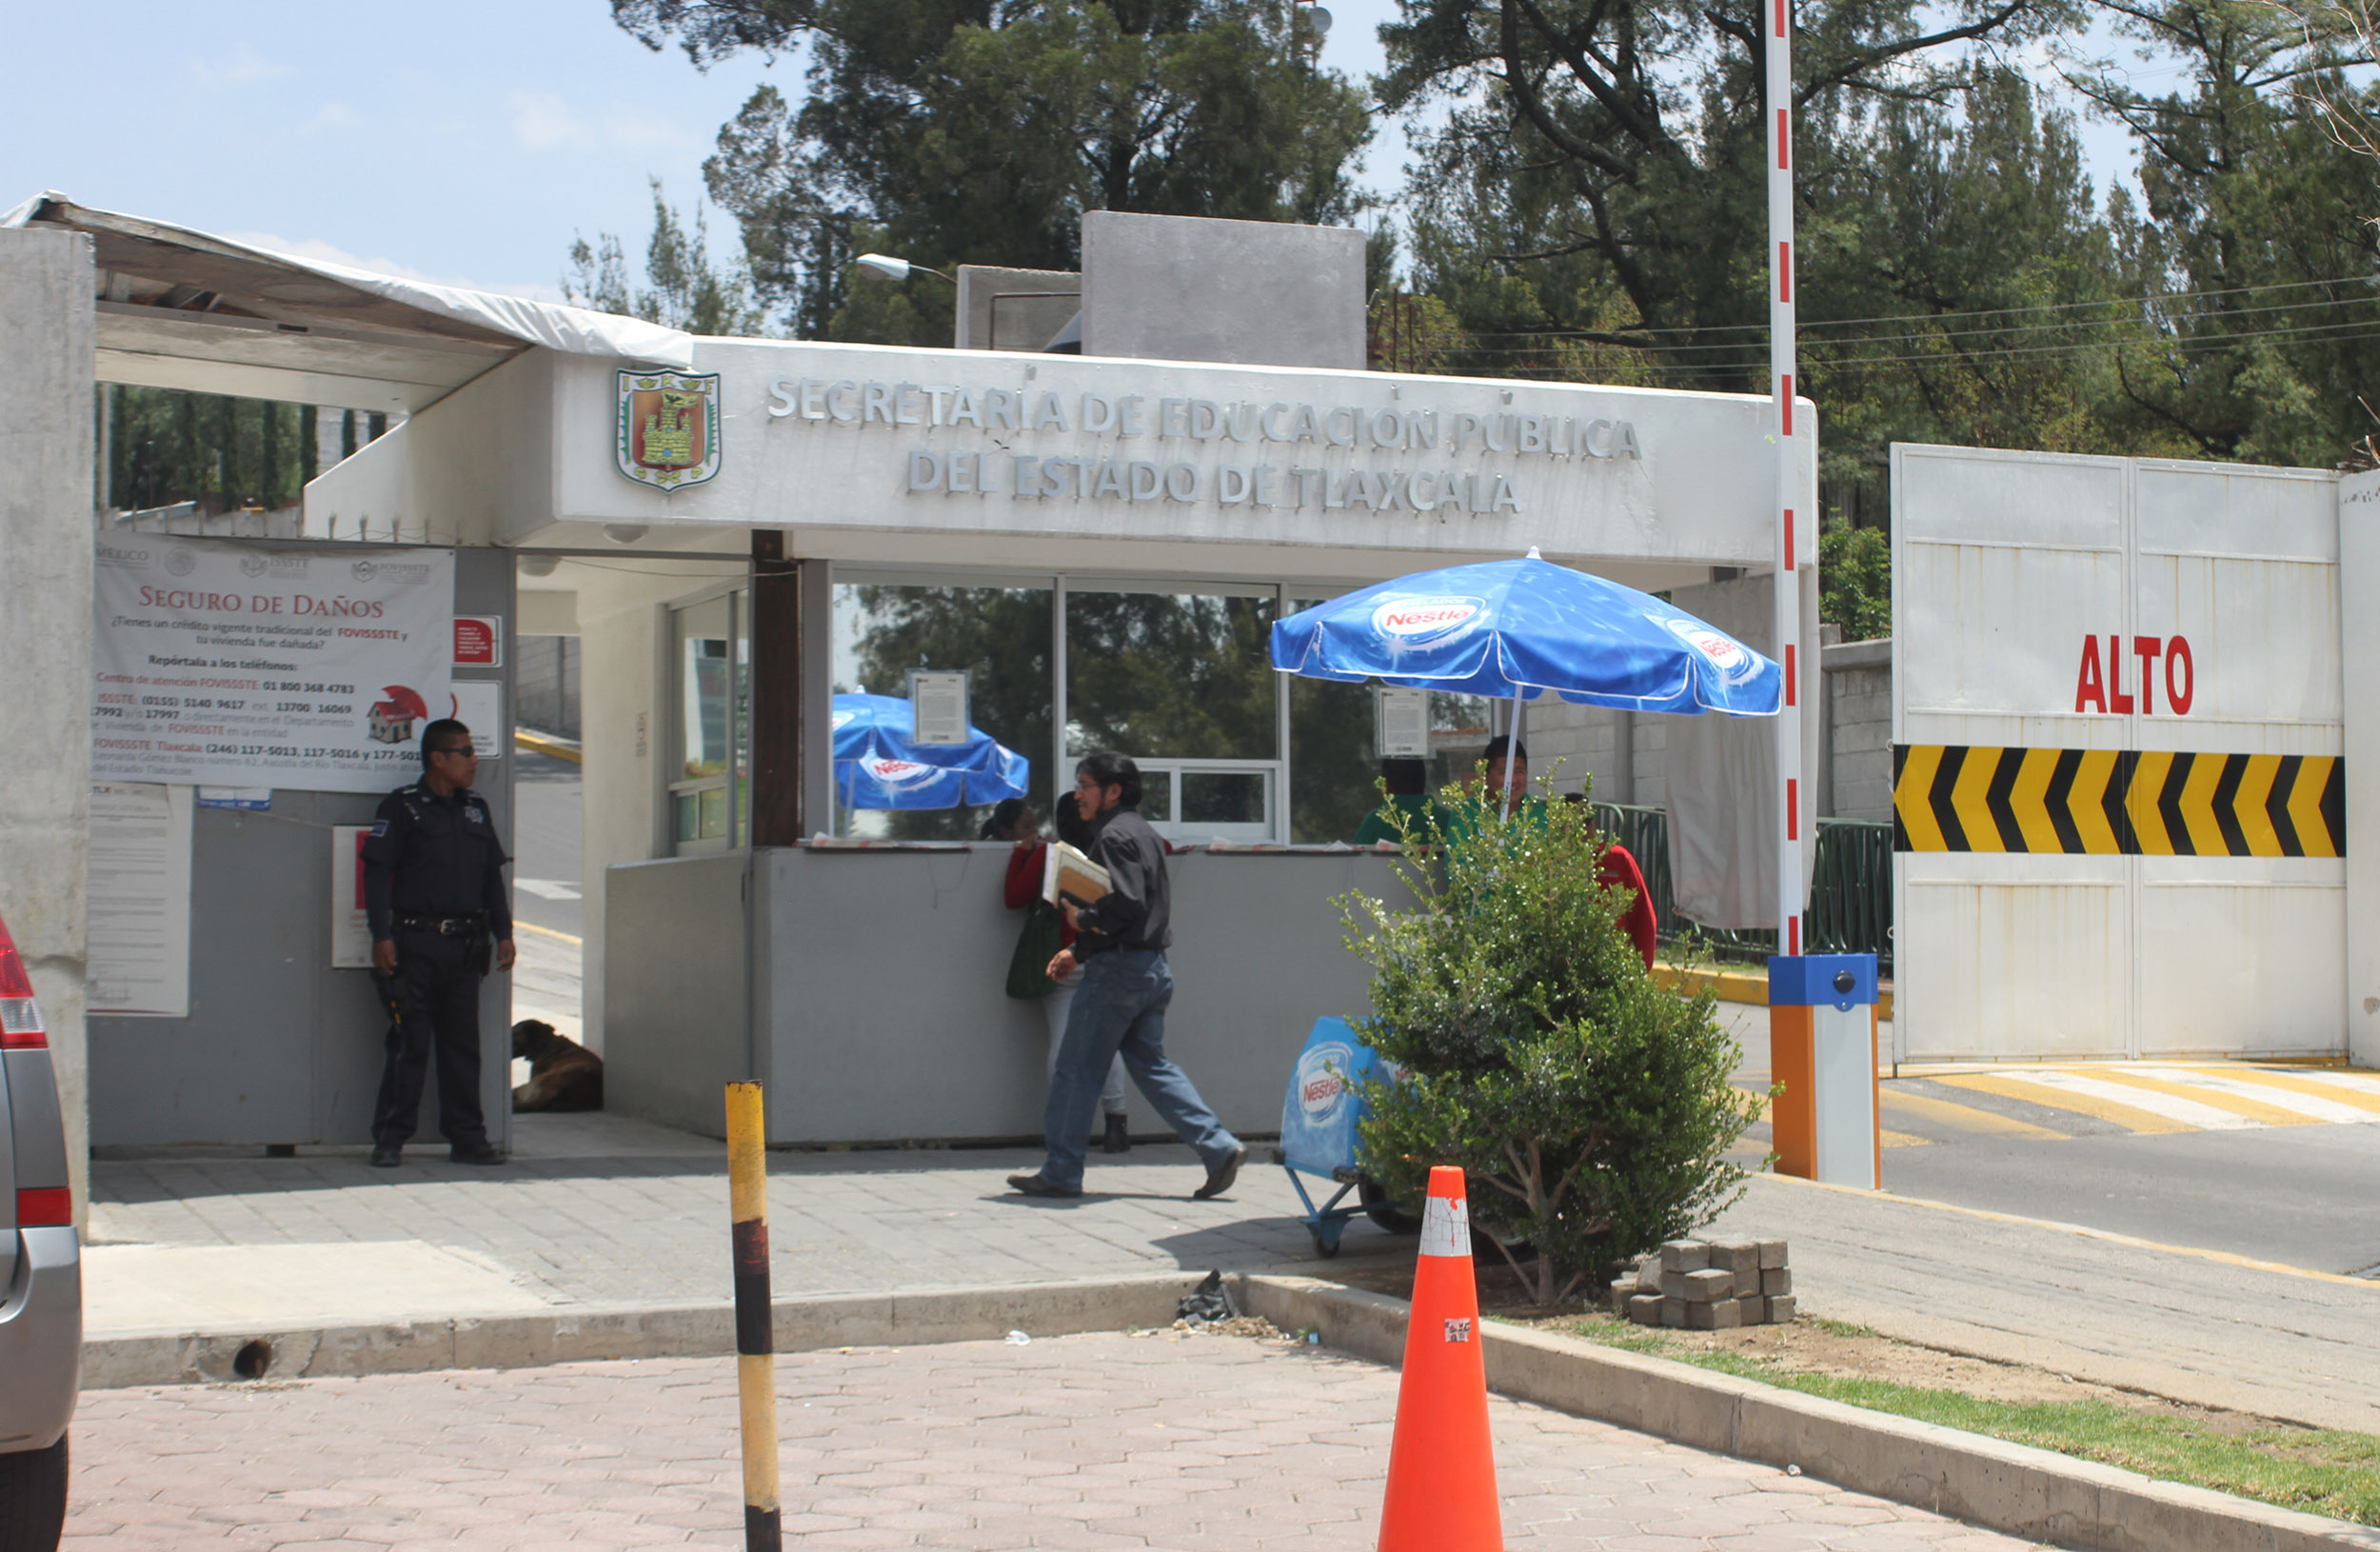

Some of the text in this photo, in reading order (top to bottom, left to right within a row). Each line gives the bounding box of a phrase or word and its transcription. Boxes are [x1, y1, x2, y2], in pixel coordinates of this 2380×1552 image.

[1082, 391, 1146, 435] DE
[909, 450, 1522, 513] DEL ESTADO DE TLAXCALA
[154, 620, 169, 628] un
[171, 618, 208, 630] crédito
[211, 622, 252, 634] vigente
[255, 625, 313, 636] tradicional
[315, 627, 332, 637] del
[337, 627, 399, 640] FOVISSSTE
[401, 632, 409, 643] y
[196, 635, 325, 650] tu vivienda fue dañada?
[149, 654, 207, 667] Repórtala
[209, 659, 218, 667] a
[220, 658, 237, 668] los
[96, 671, 133, 684] Centro
[136, 674, 149, 685] de
[152, 675, 197, 687] atención
[262, 681, 277, 691] 01
[279, 682, 301, 692] 800
[303, 683, 325, 693] 368
[327, 684, 355, 694] 4783
[2074, 634, 2193, 715] ALTO
[91, 706, 123, 718] 7992
[145, 708, 180, 720] 17997
[142, 695, 179, 707] (0155)
[184, 698, 211, 708] 5140
[217, 699, 245, 710] 9617
[276, 702, 310, 713] 13700
[318, 704, 353, 714] 16069
[169, 723, 227, 735] FOVISSSTE
[206, 743, 239, 755] (246)
[240, 745, 301, 758] 117-5013,
[303, 746, 360, 759] 117-5016
[362, 751, 370, 761] y
